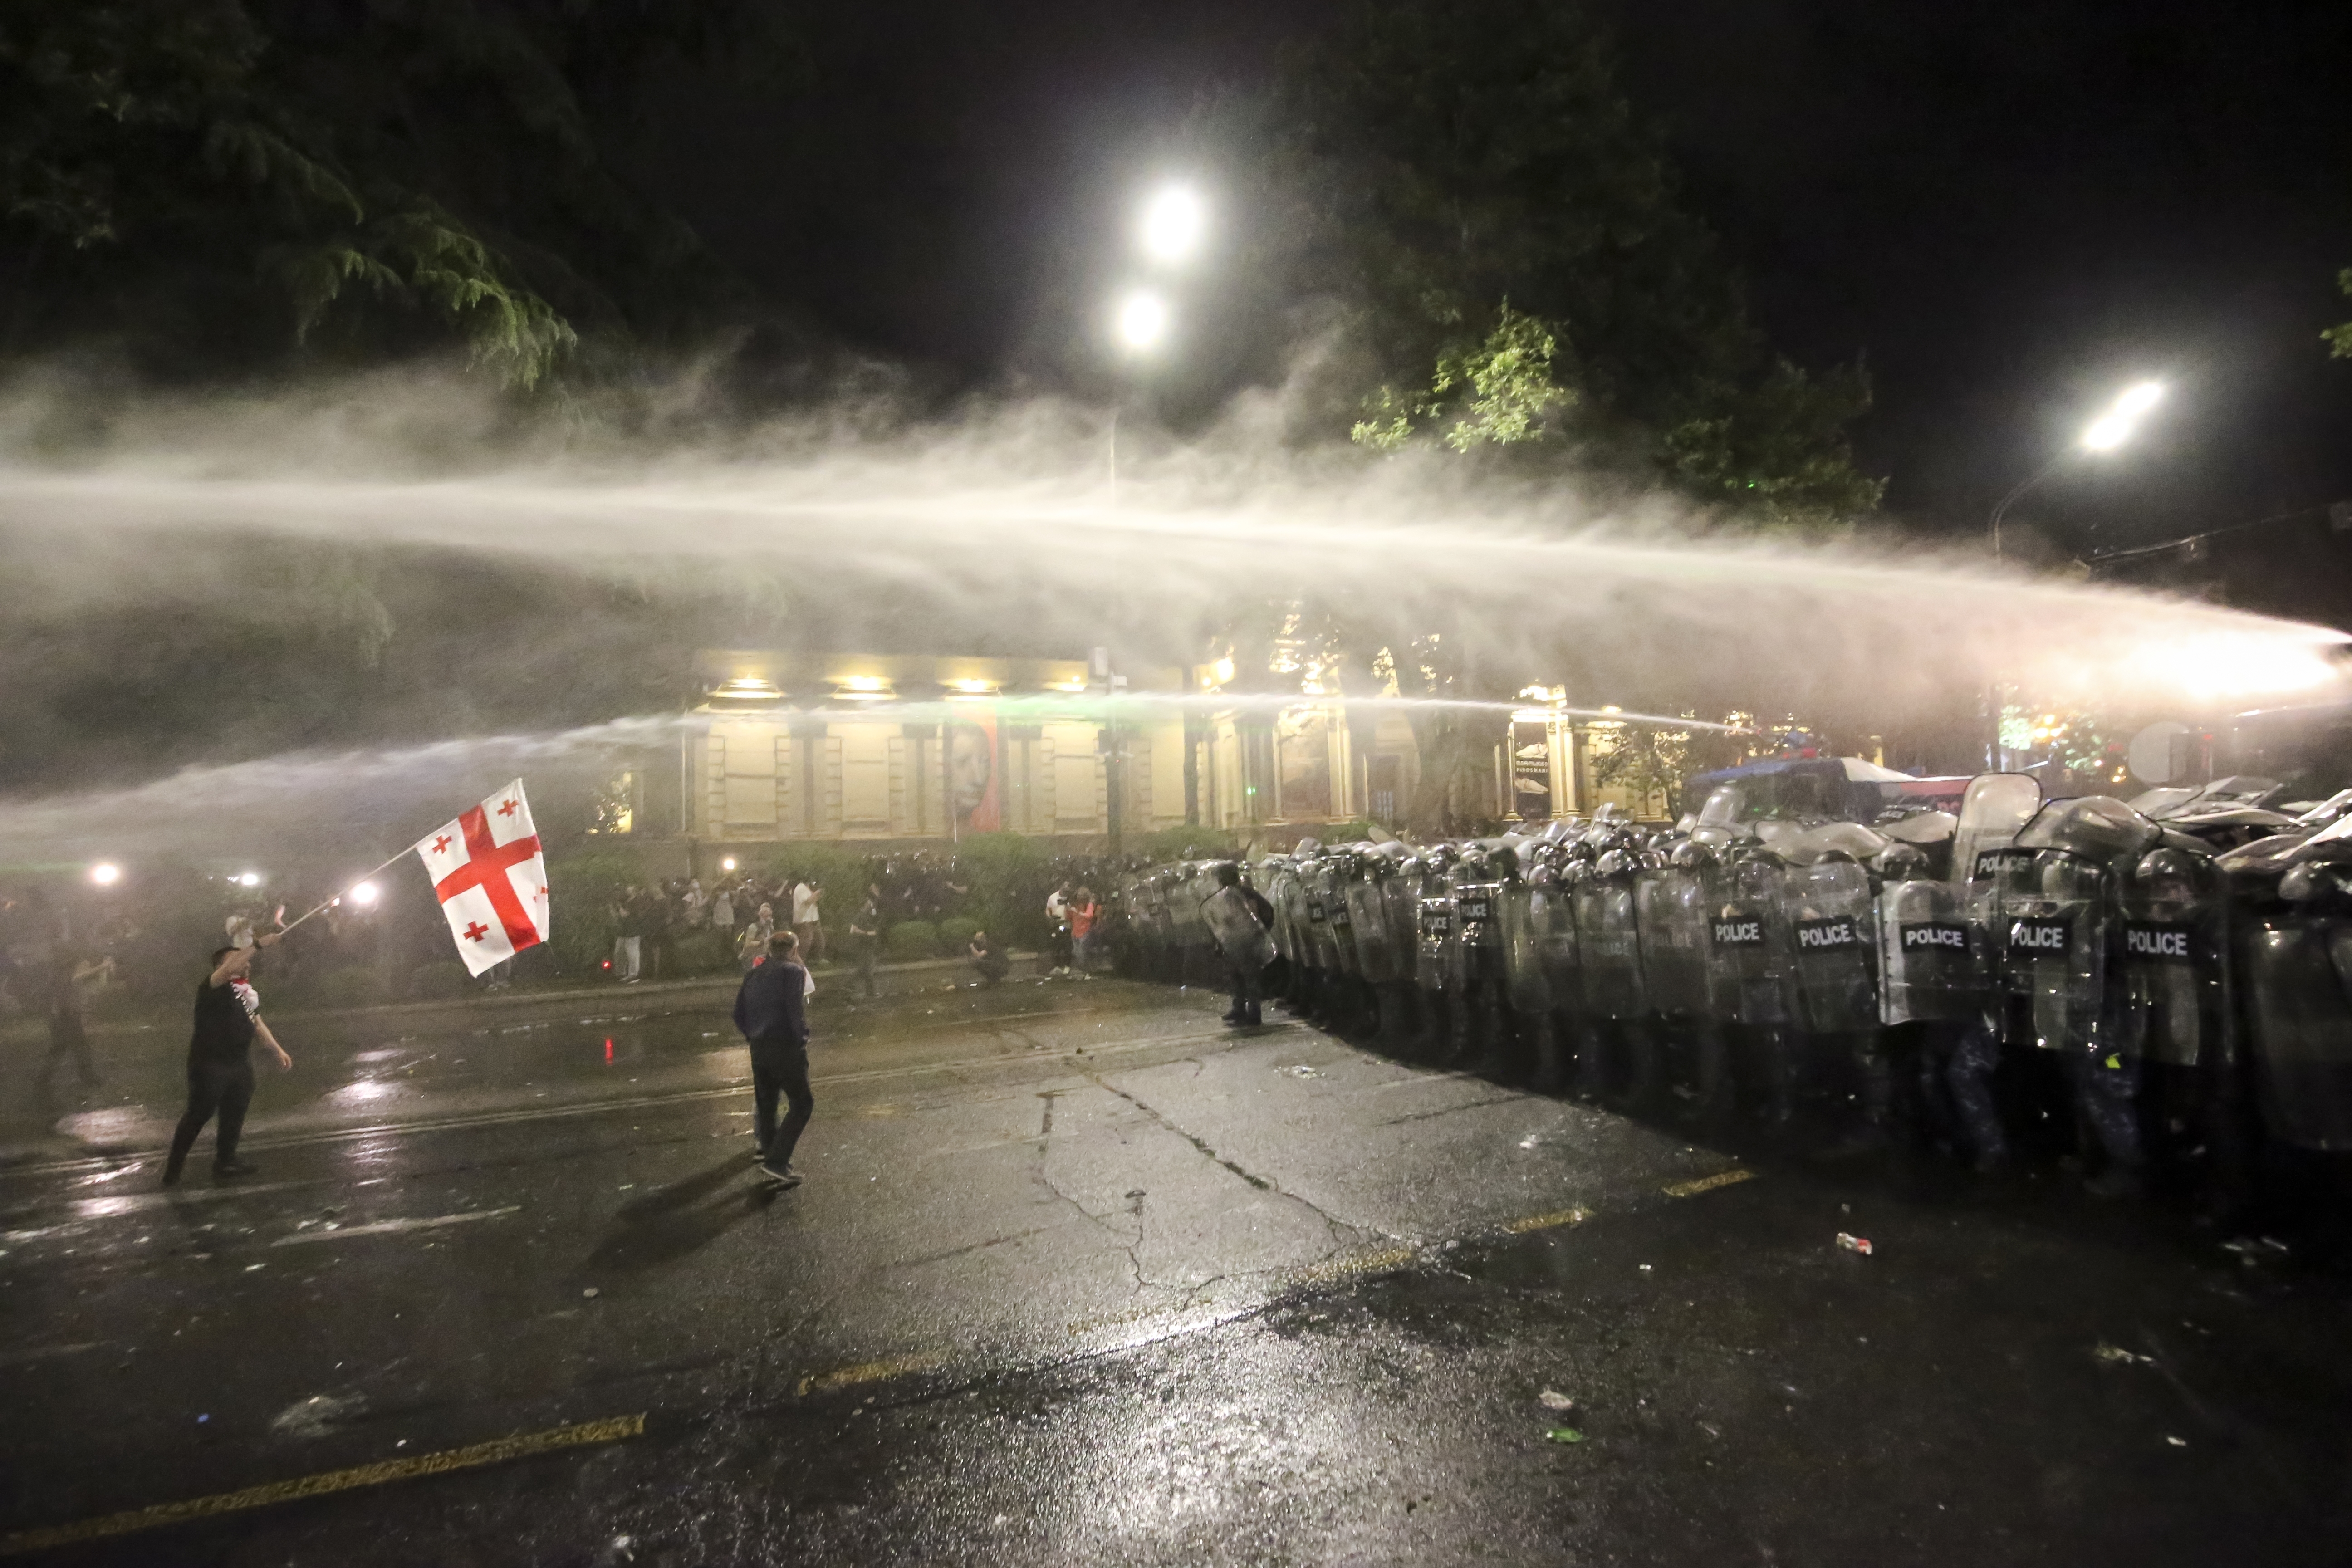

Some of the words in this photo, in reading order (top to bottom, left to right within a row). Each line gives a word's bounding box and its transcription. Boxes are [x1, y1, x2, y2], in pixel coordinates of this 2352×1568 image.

[1978, 855, 2029, 874] POLICE
[1715, 922, 1759, 941] POLICE
[1799, 924, 1852, 947] POLICE
[1906, 928, 1963, 947] POLICE
[2128, 930, 2188, 956] POLICE
